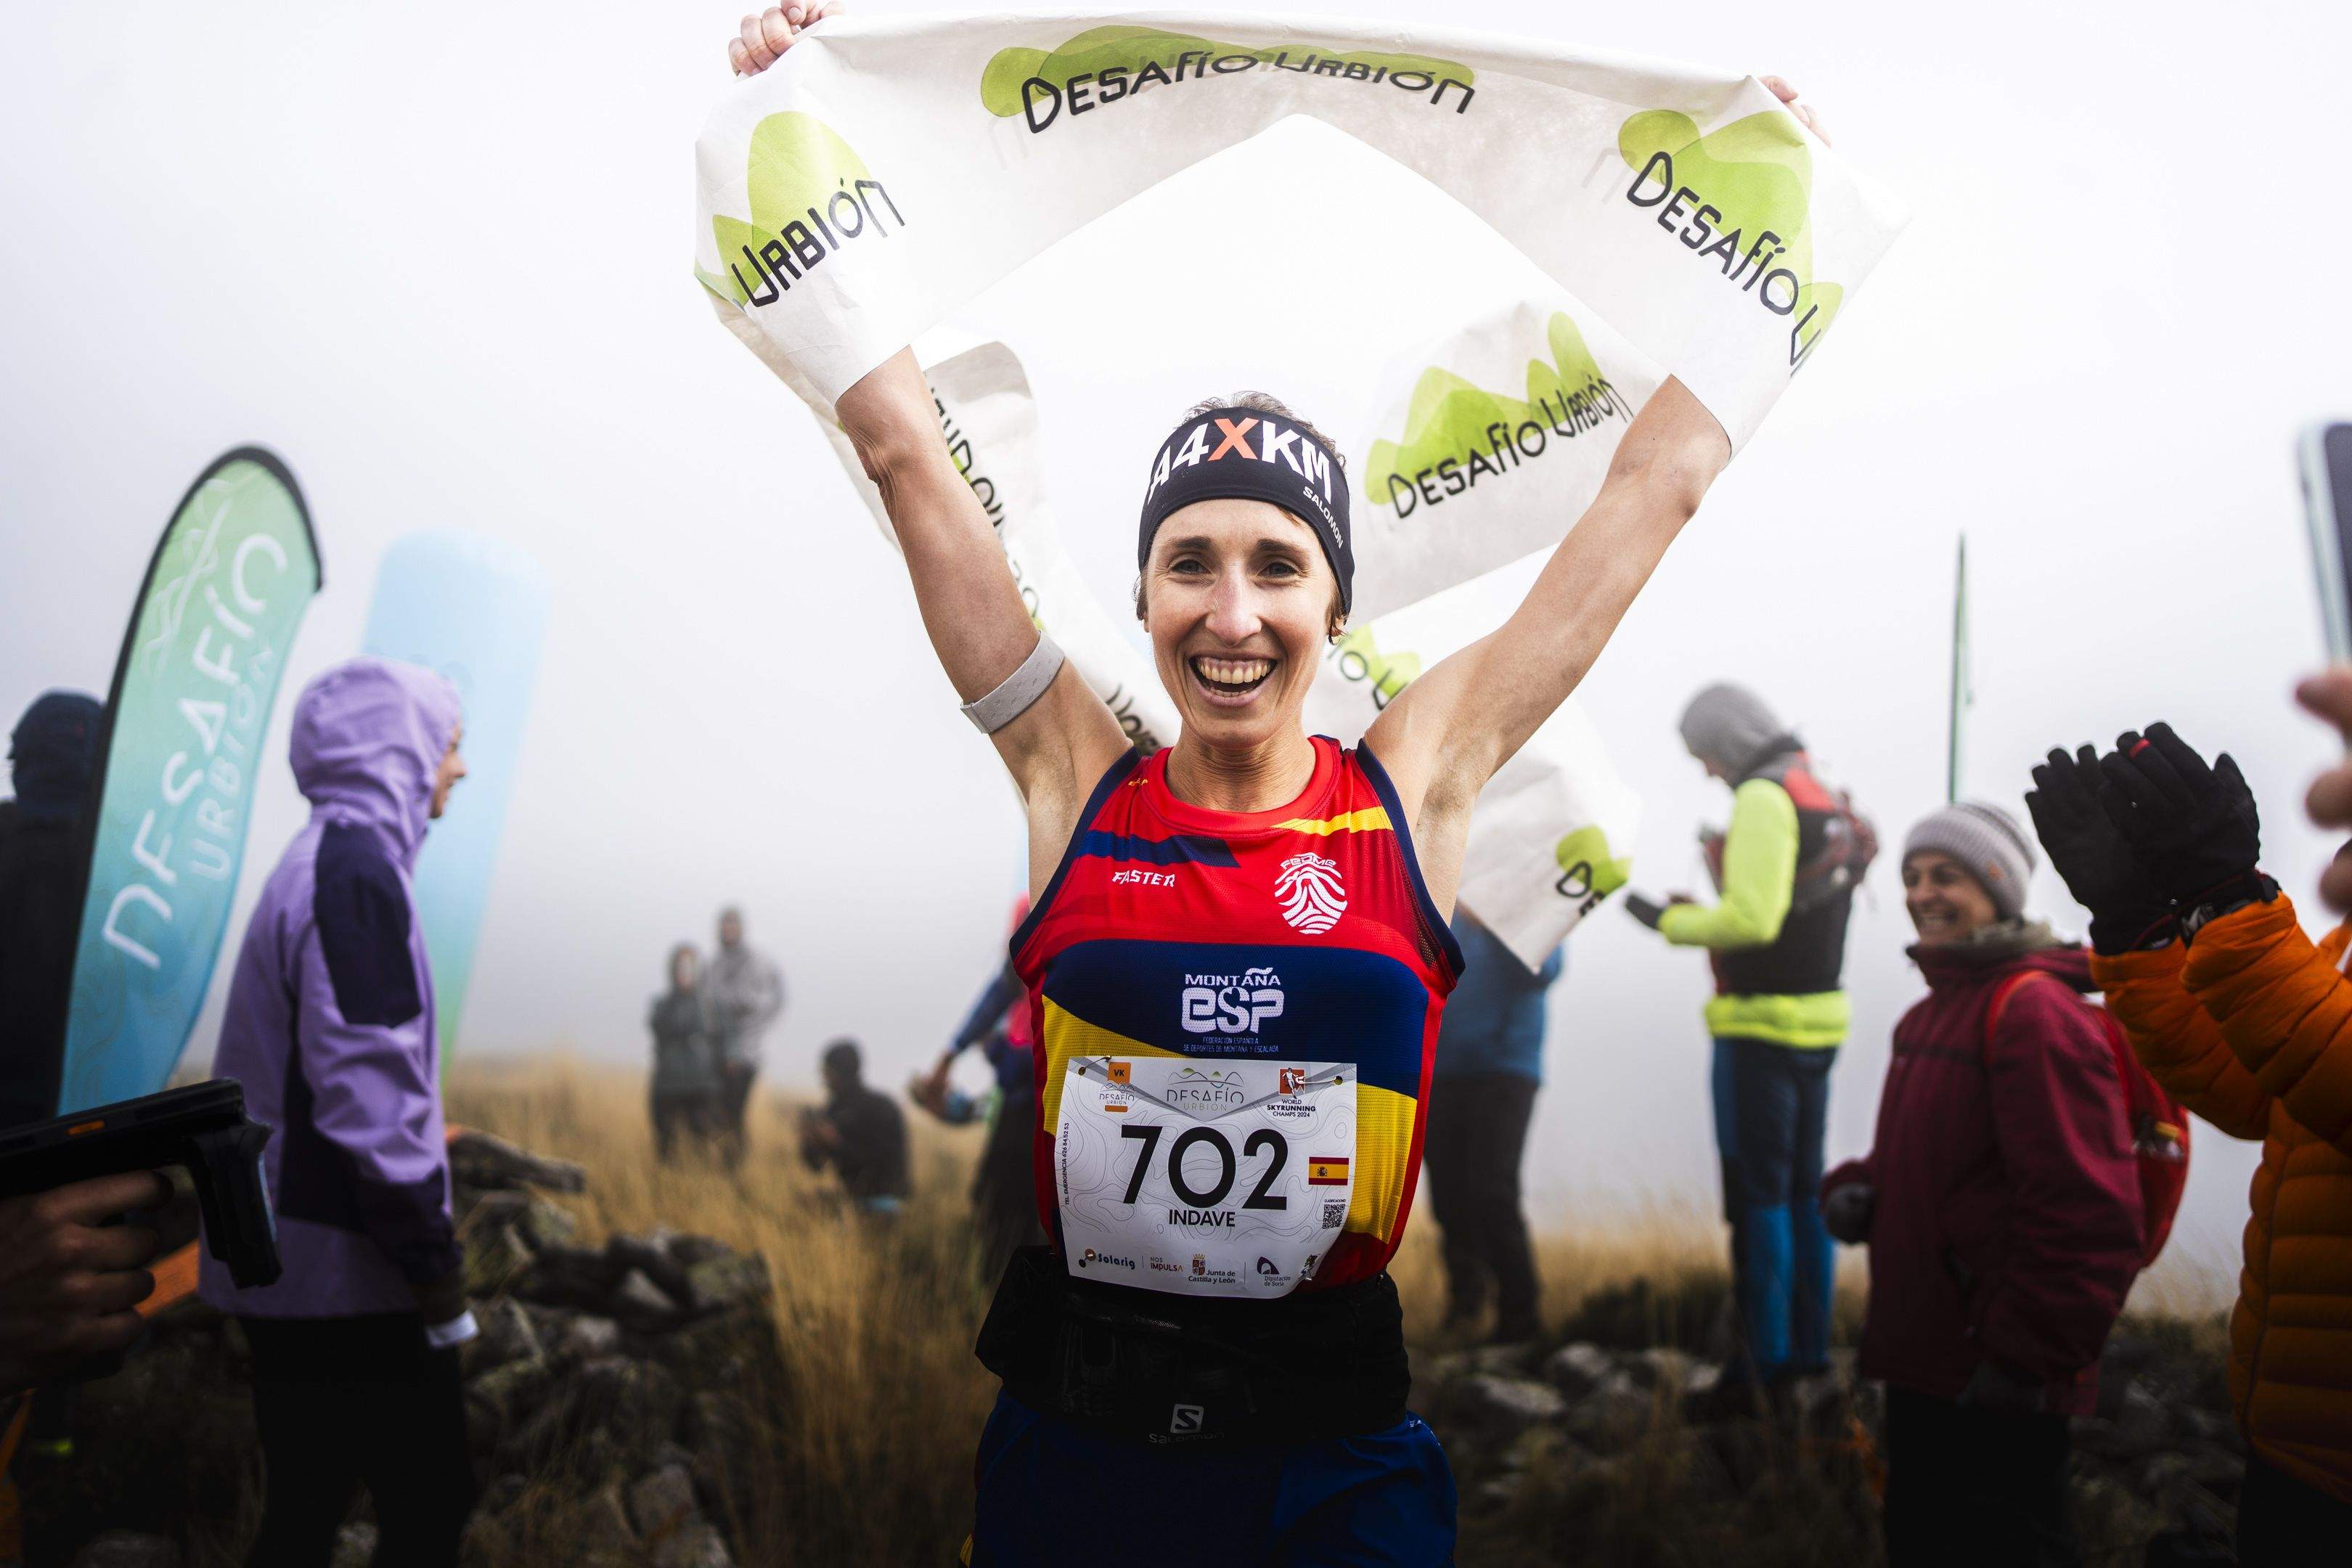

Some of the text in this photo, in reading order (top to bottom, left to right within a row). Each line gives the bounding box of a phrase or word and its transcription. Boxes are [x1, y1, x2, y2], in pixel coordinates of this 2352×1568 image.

[1303, 486, 1344, 549] SALOMON
[1112, 869, 1176, 887] FASTER
[1185, 967, 1281, 987] MONTAÑA
[1121, 1124, 1289, 1210] 702
[1169, 1210, 1236, 1228] INDAVE
[1098, 1253, 1135, 1270] Solarig
